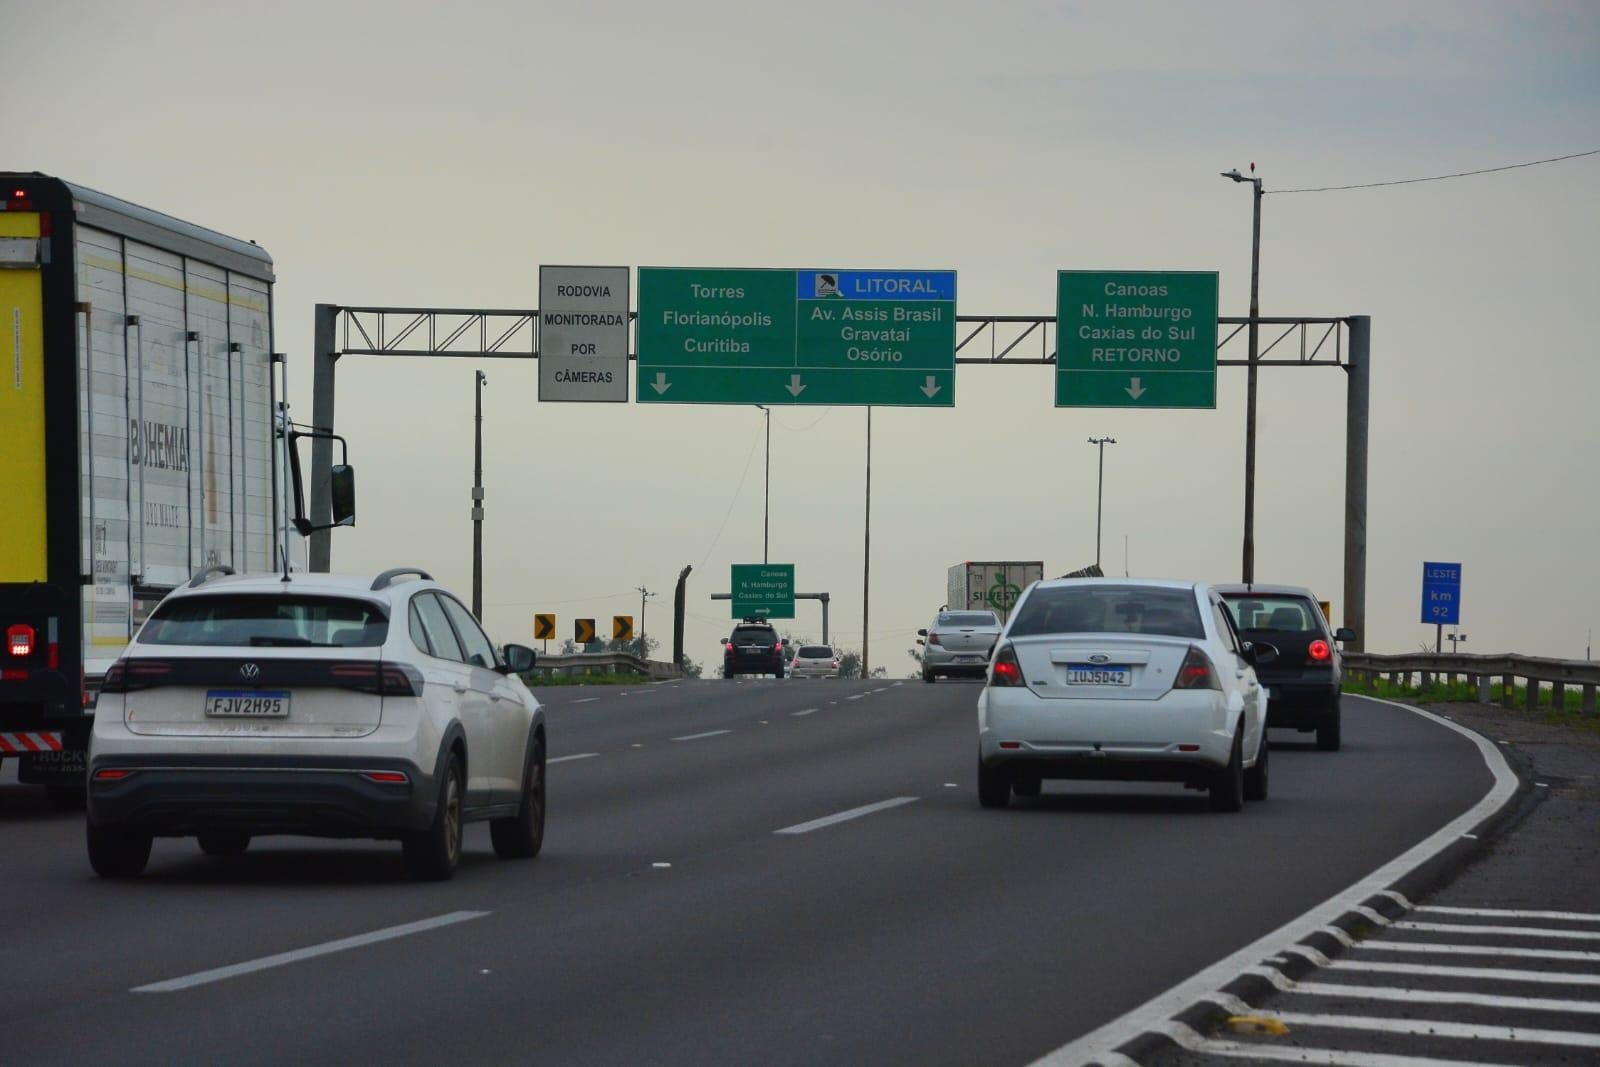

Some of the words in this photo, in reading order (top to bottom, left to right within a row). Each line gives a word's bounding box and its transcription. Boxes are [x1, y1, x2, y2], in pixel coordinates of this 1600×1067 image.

[557, 285, 611, 297] RODOVIA
[691, 284, 745, 299] Torres
[855, 278, 937, 293] LITORAL
[1104, 282, 1168, 296] Canoas
[811, 307, 836, 320] Av.
[841, 307, 888, 321] Assis
[893, 307, 941, 322] Brasil
[1082, 304, 1098, 317] N.
[1105, 304, 1192, 321] Hamburgo
[544, 314, 624, 326] MONITORADA
[663, 311, 772, 329] Florianópolis
[841, 327, 910, 341] Gravataí
[1079, 325, 1135, 339] Caxias
[1141, 326, 1162, 340] do
[1168, 327, 1195, 340] Sul
[571, 343, 596, 355] POR
[684, 338, 750, 353] Curitiba
[847, 347, 902, 362] Osório
[1092, 348, 1181, 362] RETORNO
[555, 369, 613, 383] CÂMERAS
[761, 570, 787, 578] Canoas
[1427, 569, 1457, 579] LESTE
[751, 581, 787, 589] Hamburgo
[1432, 606, 1448, 617] 92
[214, 698, 281, 713] FJV2H95
